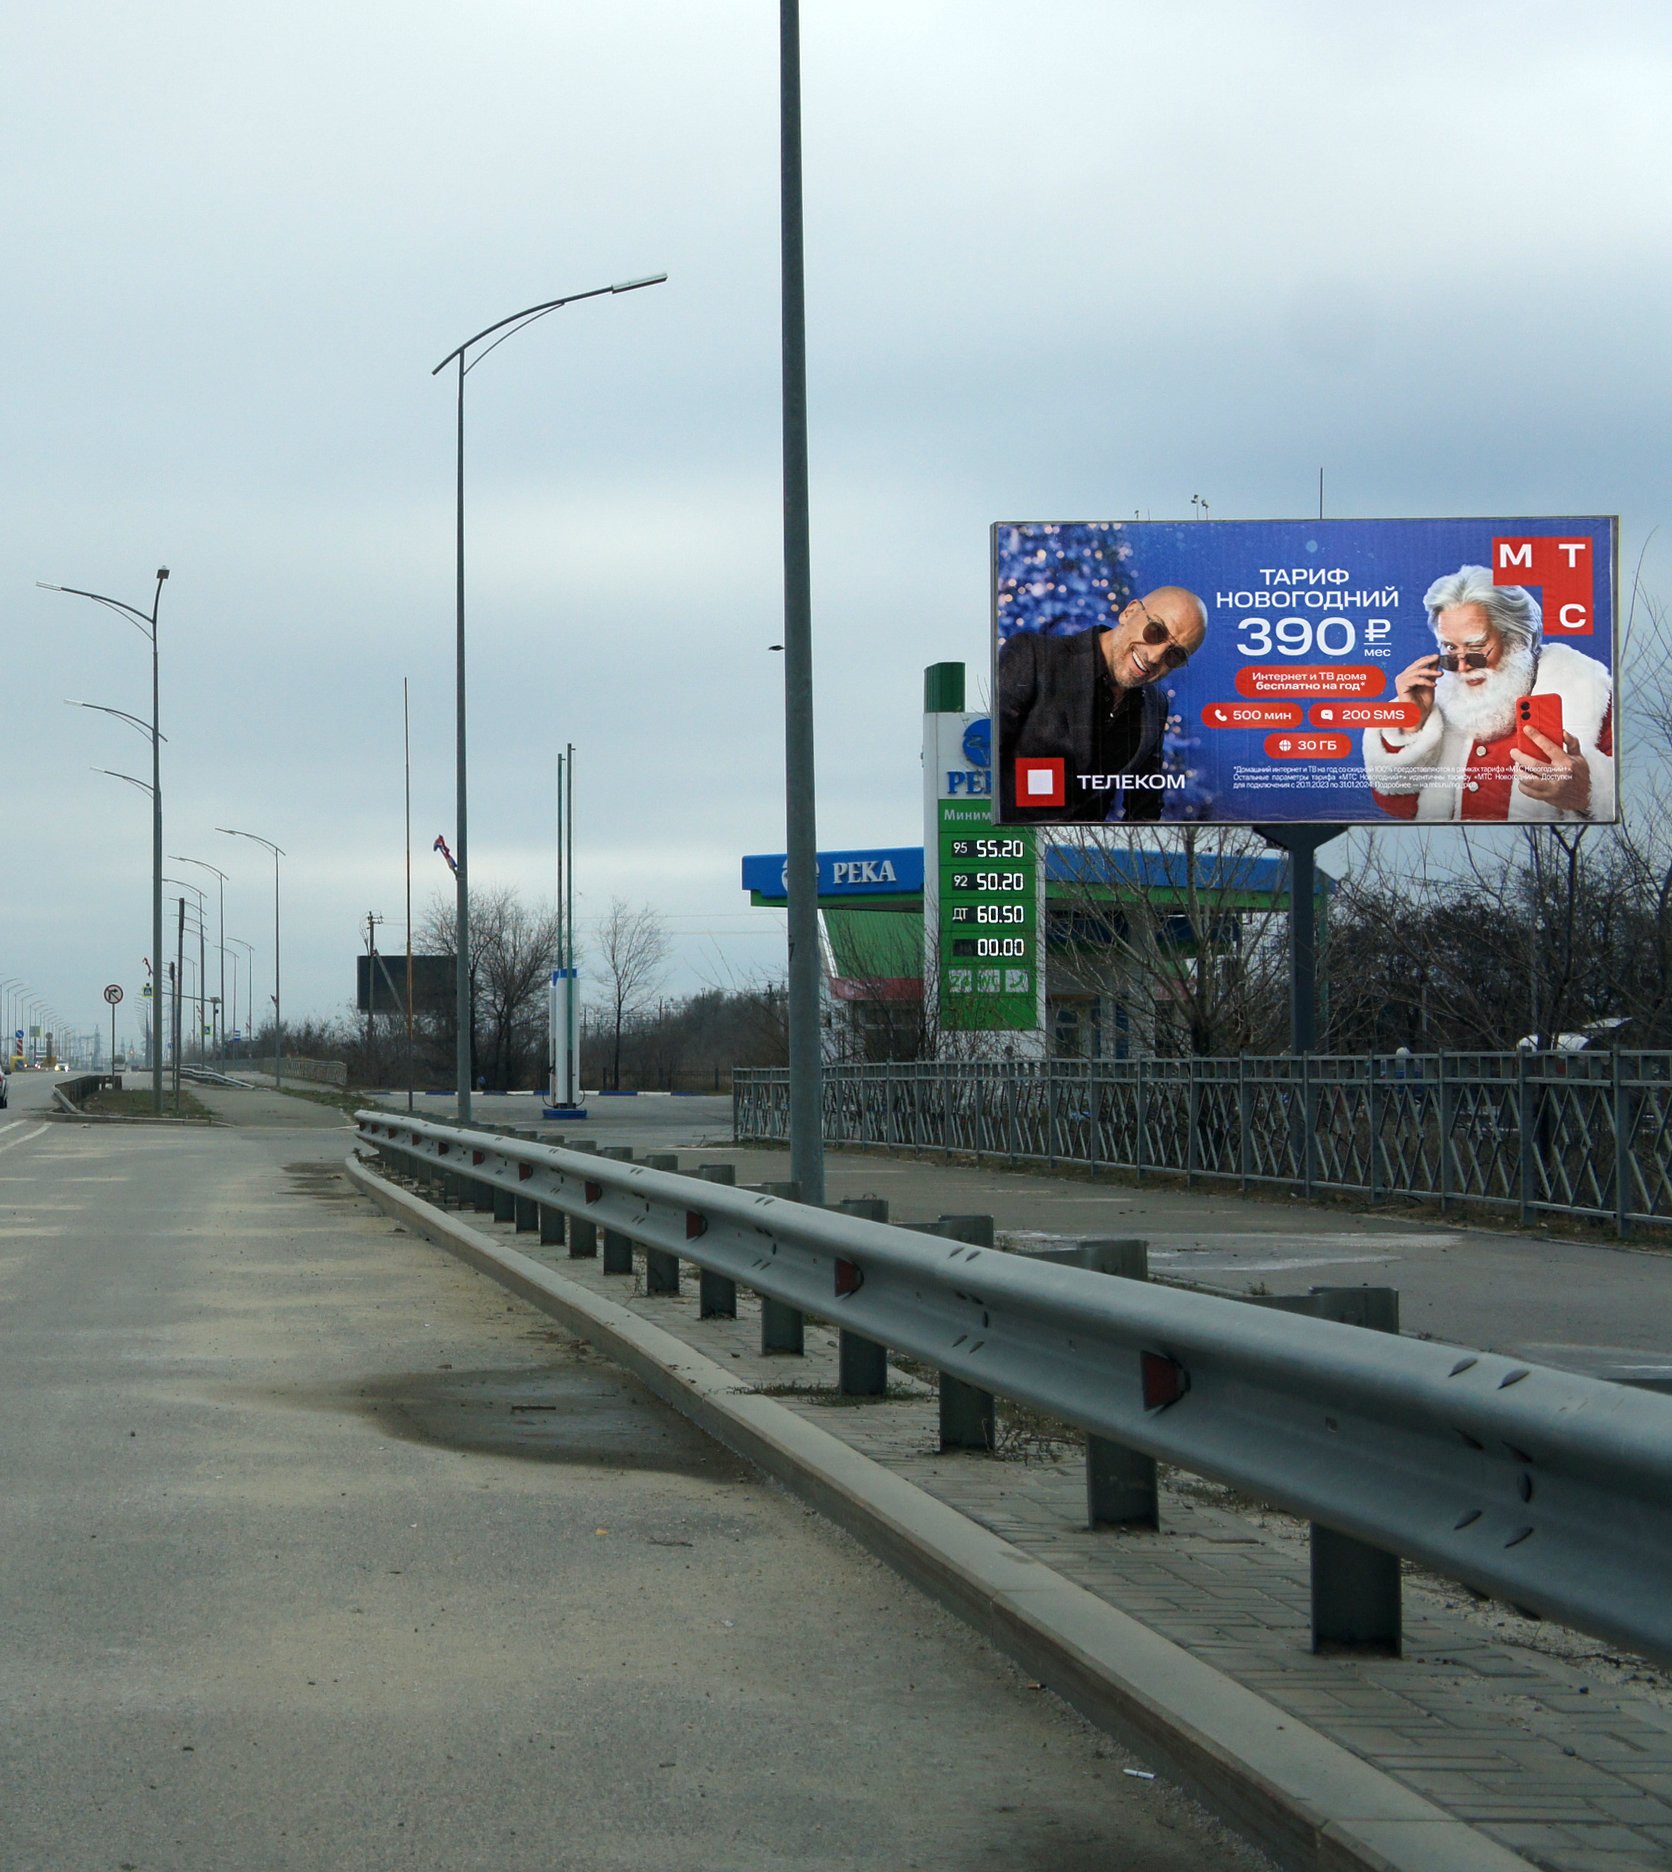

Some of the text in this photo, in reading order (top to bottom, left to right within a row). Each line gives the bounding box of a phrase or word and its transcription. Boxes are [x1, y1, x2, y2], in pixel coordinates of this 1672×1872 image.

[1260, 568, 1350, 586] ТАРИФ
[1216, 586, 1399, 611] НОВОГОДНИЙ
[1559, 603, 1586, 628] С
[1236, 616, 1356, 656] 390
[1364, 648, 1391, 657] мес
[1252, 672, 1308, 682] Интернет
[1318, 672, 1335, 681] ТВ
[1336, 673, 1367, 682] дома
[1256, 682, 1321, 692] бесплатно
[1232, 710, 1292, 720] 500 мин
[1342, 710, 1406, 720] 200 SMS
[1297, 740, 1338, 750] 30 ГБ
[1076, 774, 1186, 790] ТЕЛЕКОМ
[1271, 774, 1310, 782] параметры
[1311, 774, 1336, 782] тарифа
[953, 840, 1024, 858] 95 55.20
[832, 860, 897, 884] РЕКА
[954, 872, 1024, 891] 92 50.20
[952, 905, 1024, 924] ДТ 60.50
[977, 938, 1024, 957] 00.00
